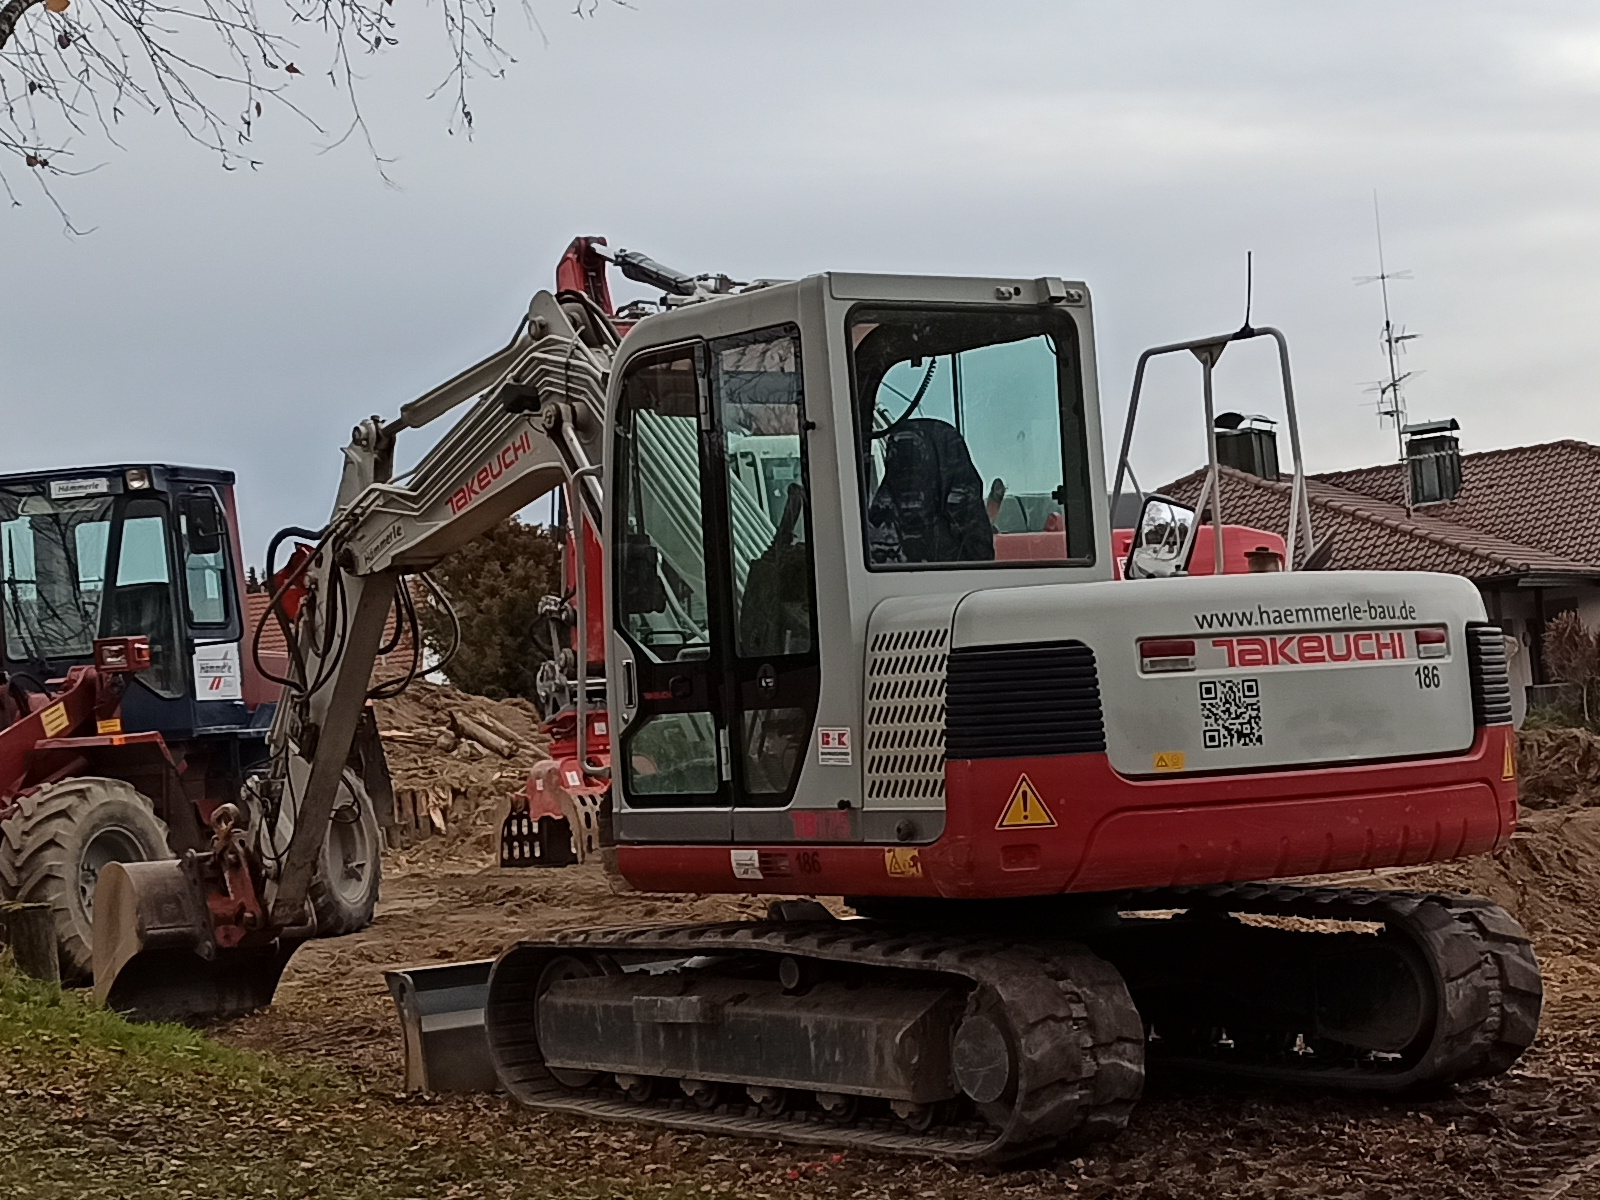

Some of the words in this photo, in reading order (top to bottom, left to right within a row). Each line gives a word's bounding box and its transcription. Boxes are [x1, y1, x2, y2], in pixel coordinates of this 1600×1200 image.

[445, 431, 531, 515] TAKEUCHI
[1194, 600, 1416, 629] www.haemmerle-bau.de
[1212, 632, 1406, 667] TAKEUCHI
[1415, 666, 1440, 689] 186
[795, 851, 822, 874] 186
